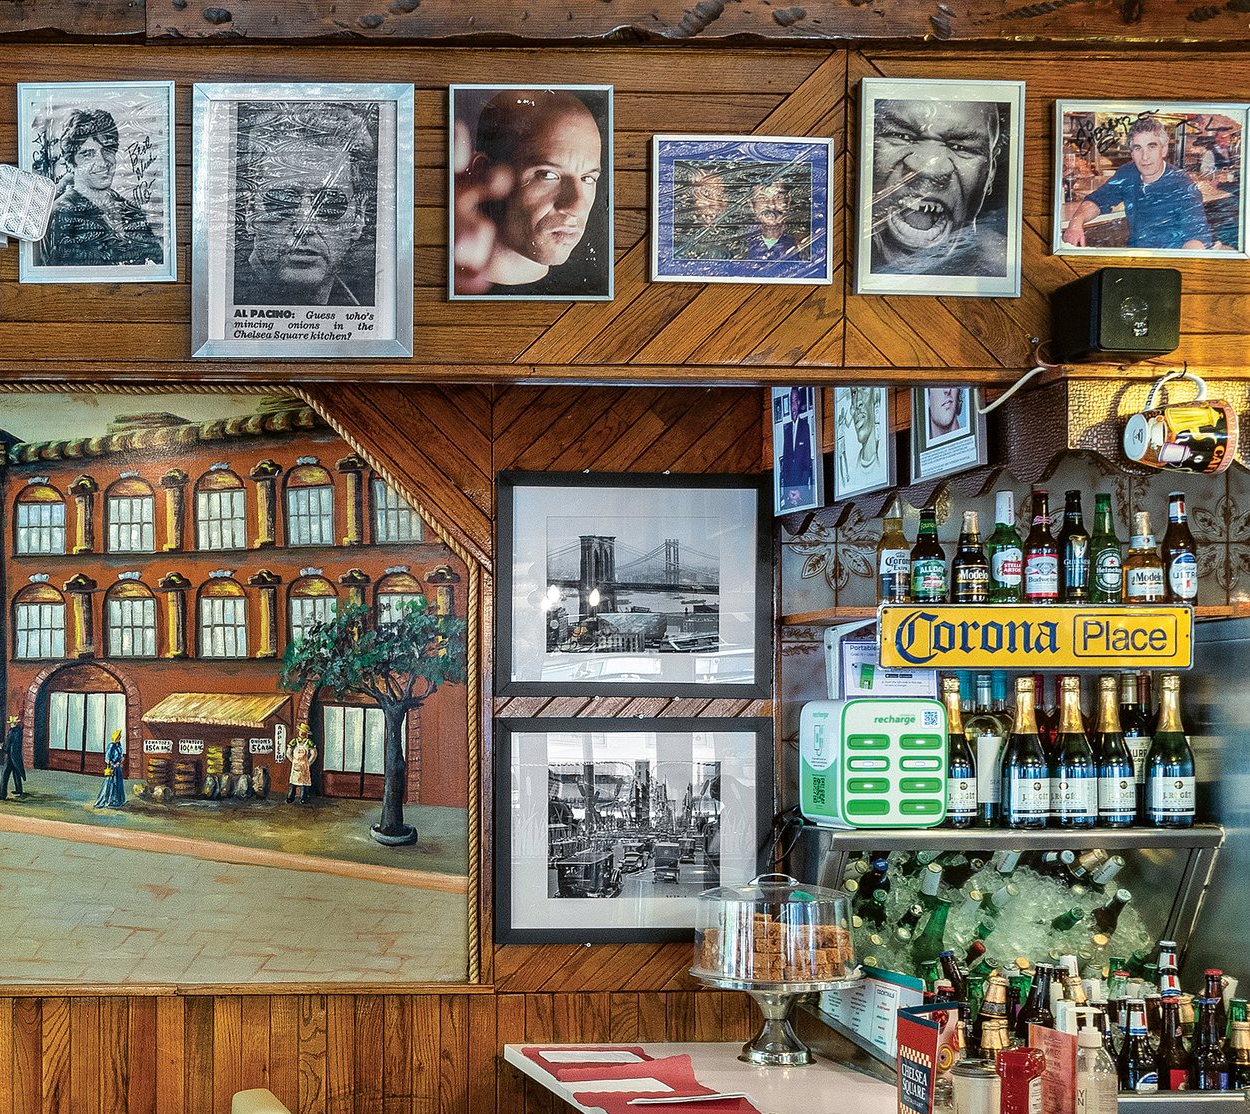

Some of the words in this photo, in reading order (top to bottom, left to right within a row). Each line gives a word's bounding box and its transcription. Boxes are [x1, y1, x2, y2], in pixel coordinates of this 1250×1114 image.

[234, 309, 248, 318] AL
[250, 309, 295, 319] PACINO:
[305, 311, 336, 320] Guess
[345, 312, 374, 321] who's
[234, 320, 274, 330] mincing
[288, 321, 320, 329] onions
[334, 321, 344, 330] in
[357, 322, 374, 331] the
[234, 330, 272, 339] Chelsea
[274, 331, 309, 340] Square
[310, 331, 352, 341] kitchen?
[960, 569, 989, 581] Modelo
[895, 610, 1061, 665] Corona
[1082, 621, 1168, 652] Place
[874, 714, 916, 726] recharge
[901, 1063, 928, 1087] CHELSEA
[902, 1077, 926, 1101] SQUARE
